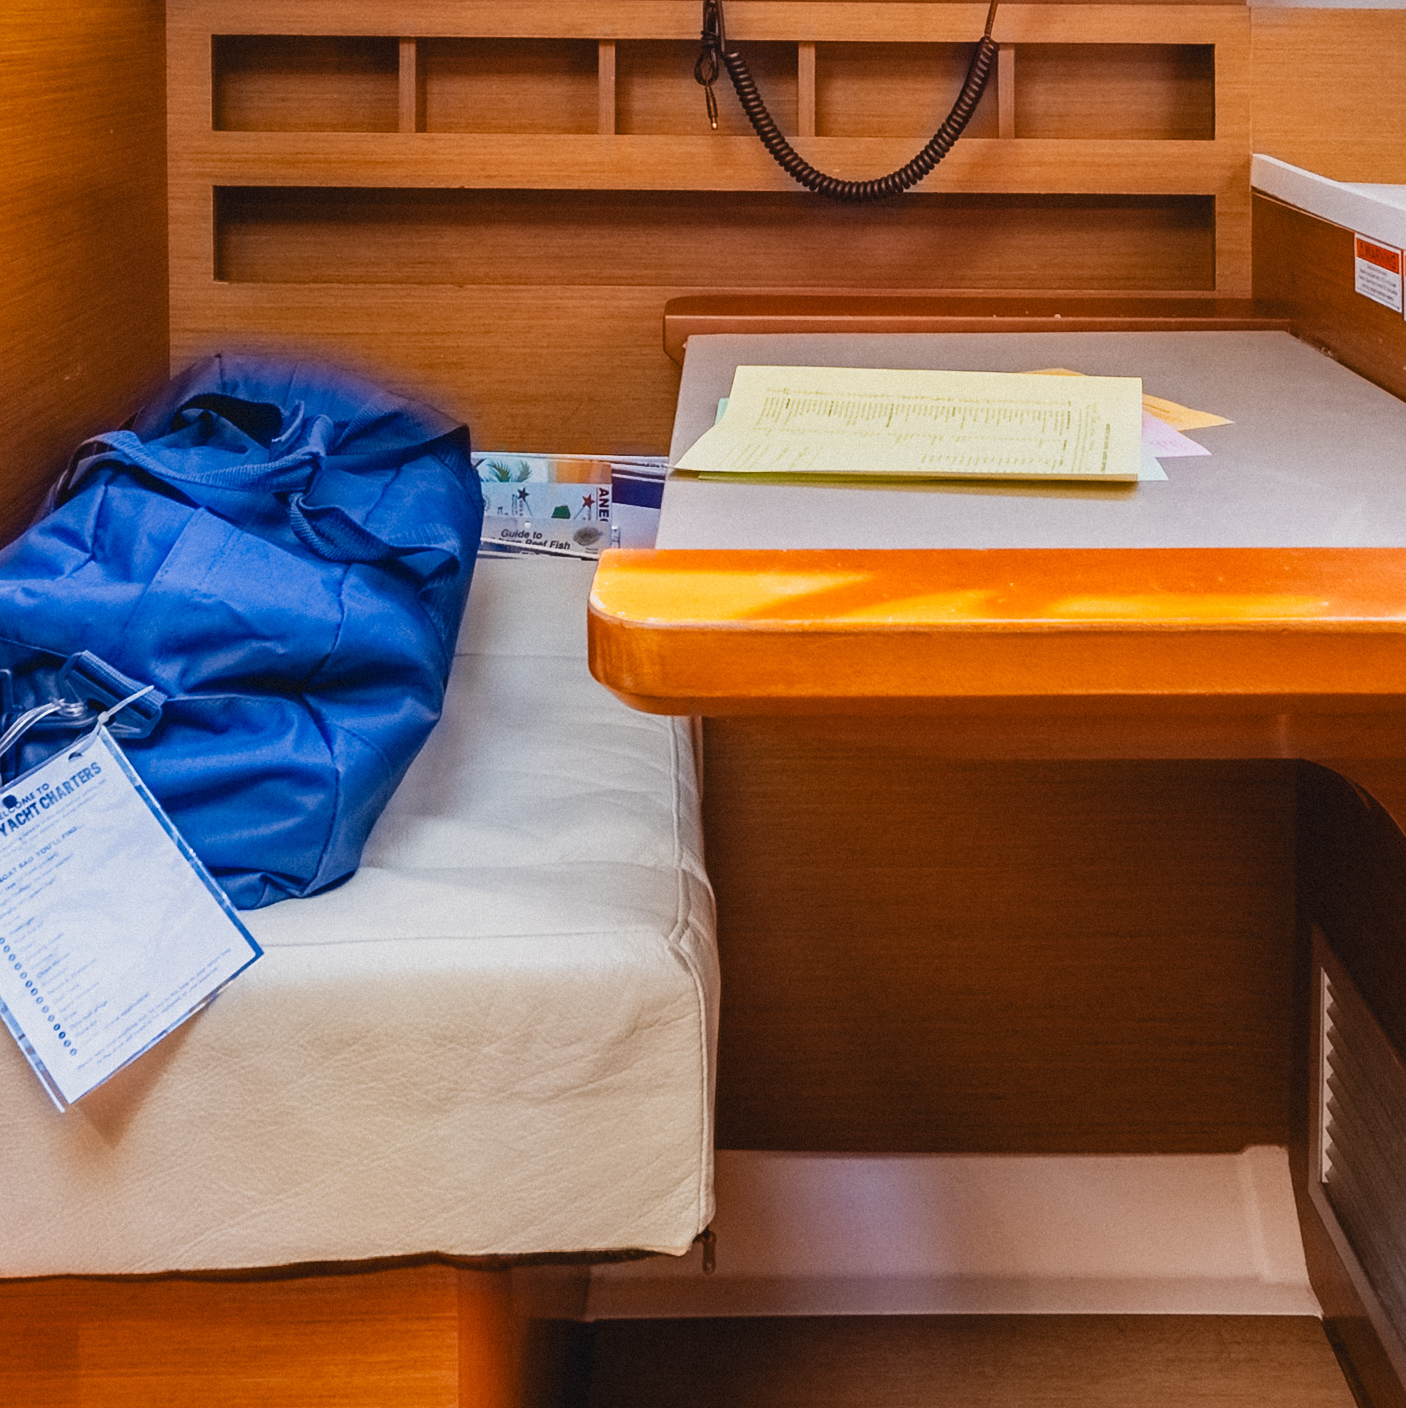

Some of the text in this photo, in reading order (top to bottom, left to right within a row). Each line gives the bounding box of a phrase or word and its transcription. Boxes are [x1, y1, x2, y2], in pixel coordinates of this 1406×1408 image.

[501, 528, 543, 539] Guide to
[549, 541, 571, 550] Fish
[35, 781, 51, 795] TO
[38, 760, 103, 810] CHARTERS
